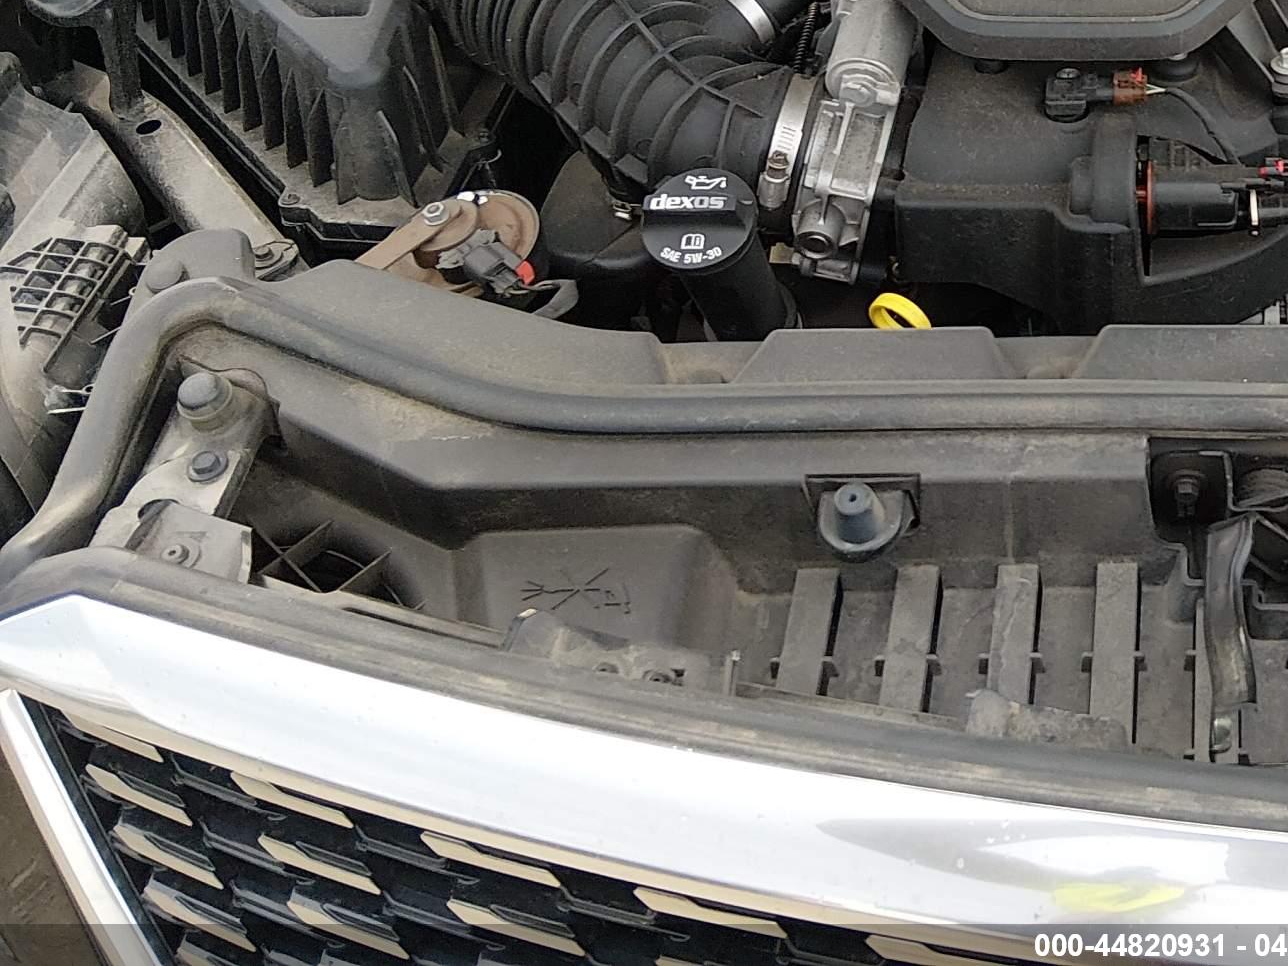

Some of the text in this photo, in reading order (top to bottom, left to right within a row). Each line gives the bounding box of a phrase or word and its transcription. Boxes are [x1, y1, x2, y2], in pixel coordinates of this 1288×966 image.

[649, 193, 728, 211] dexos
[660, 246, 722, 264] SAE 5W-30
